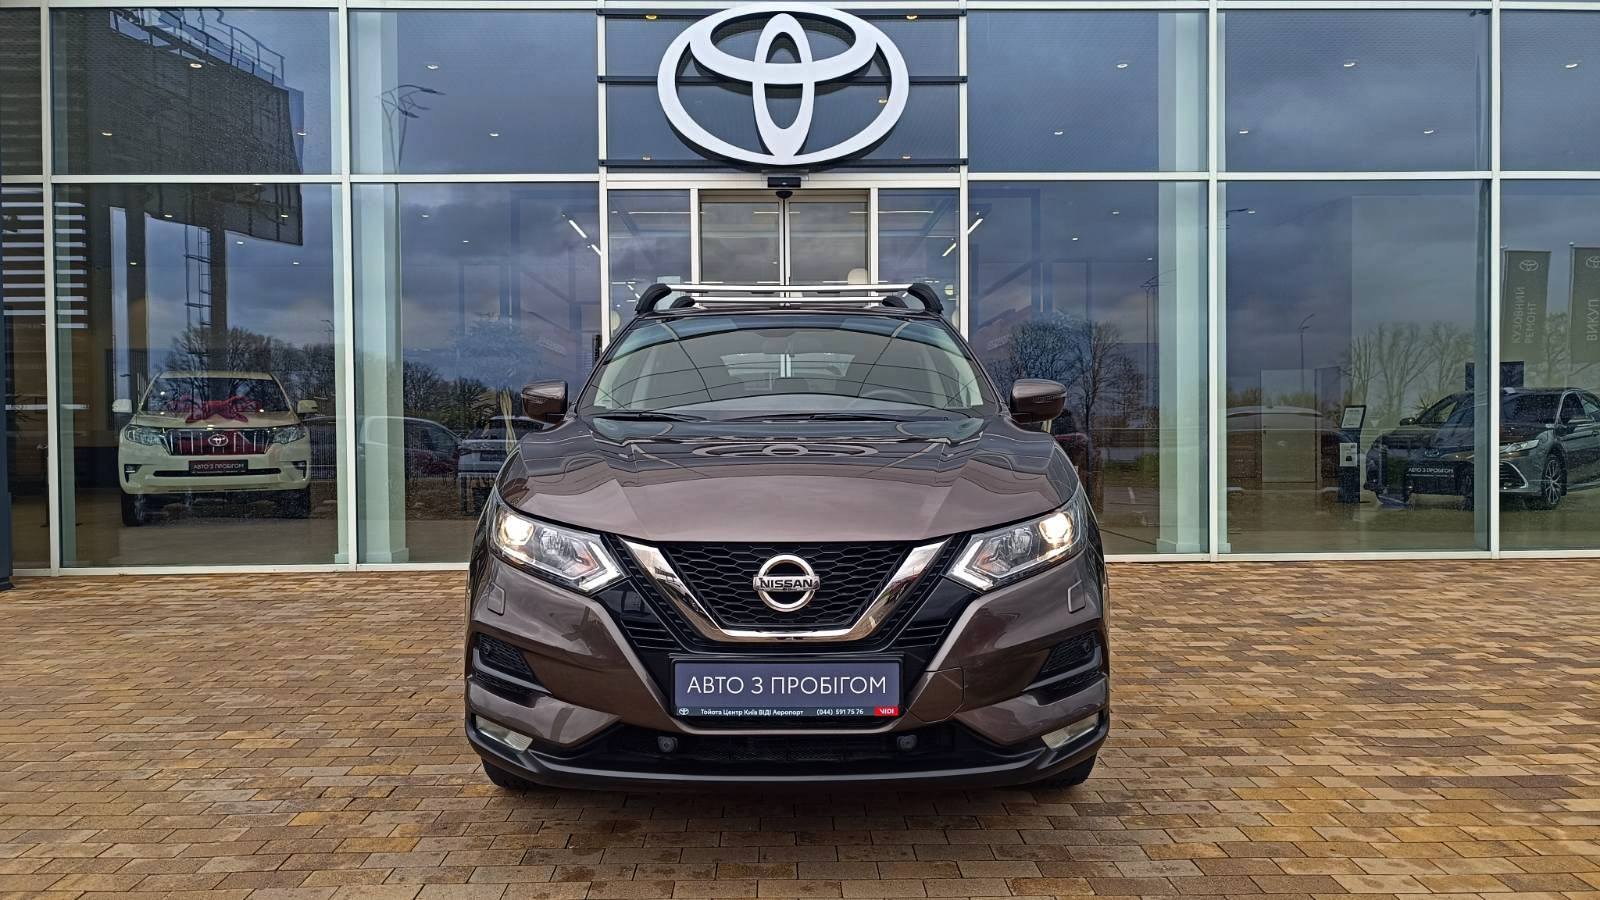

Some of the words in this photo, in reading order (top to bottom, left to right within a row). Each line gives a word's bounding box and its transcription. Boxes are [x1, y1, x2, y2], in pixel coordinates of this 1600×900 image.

[1524, 302, 1537, 344] РЕМОНТ
[1586, 299, 1600, 341] ВИКУП
[760, 578, 813, 589] NISSAN
[687, 676, 744, 694] АВТО
[751, 676, 763, 694] З
[771, 675, 886, 694] ПРОБІГОМ
[816, 708, 833, 716] (044)
